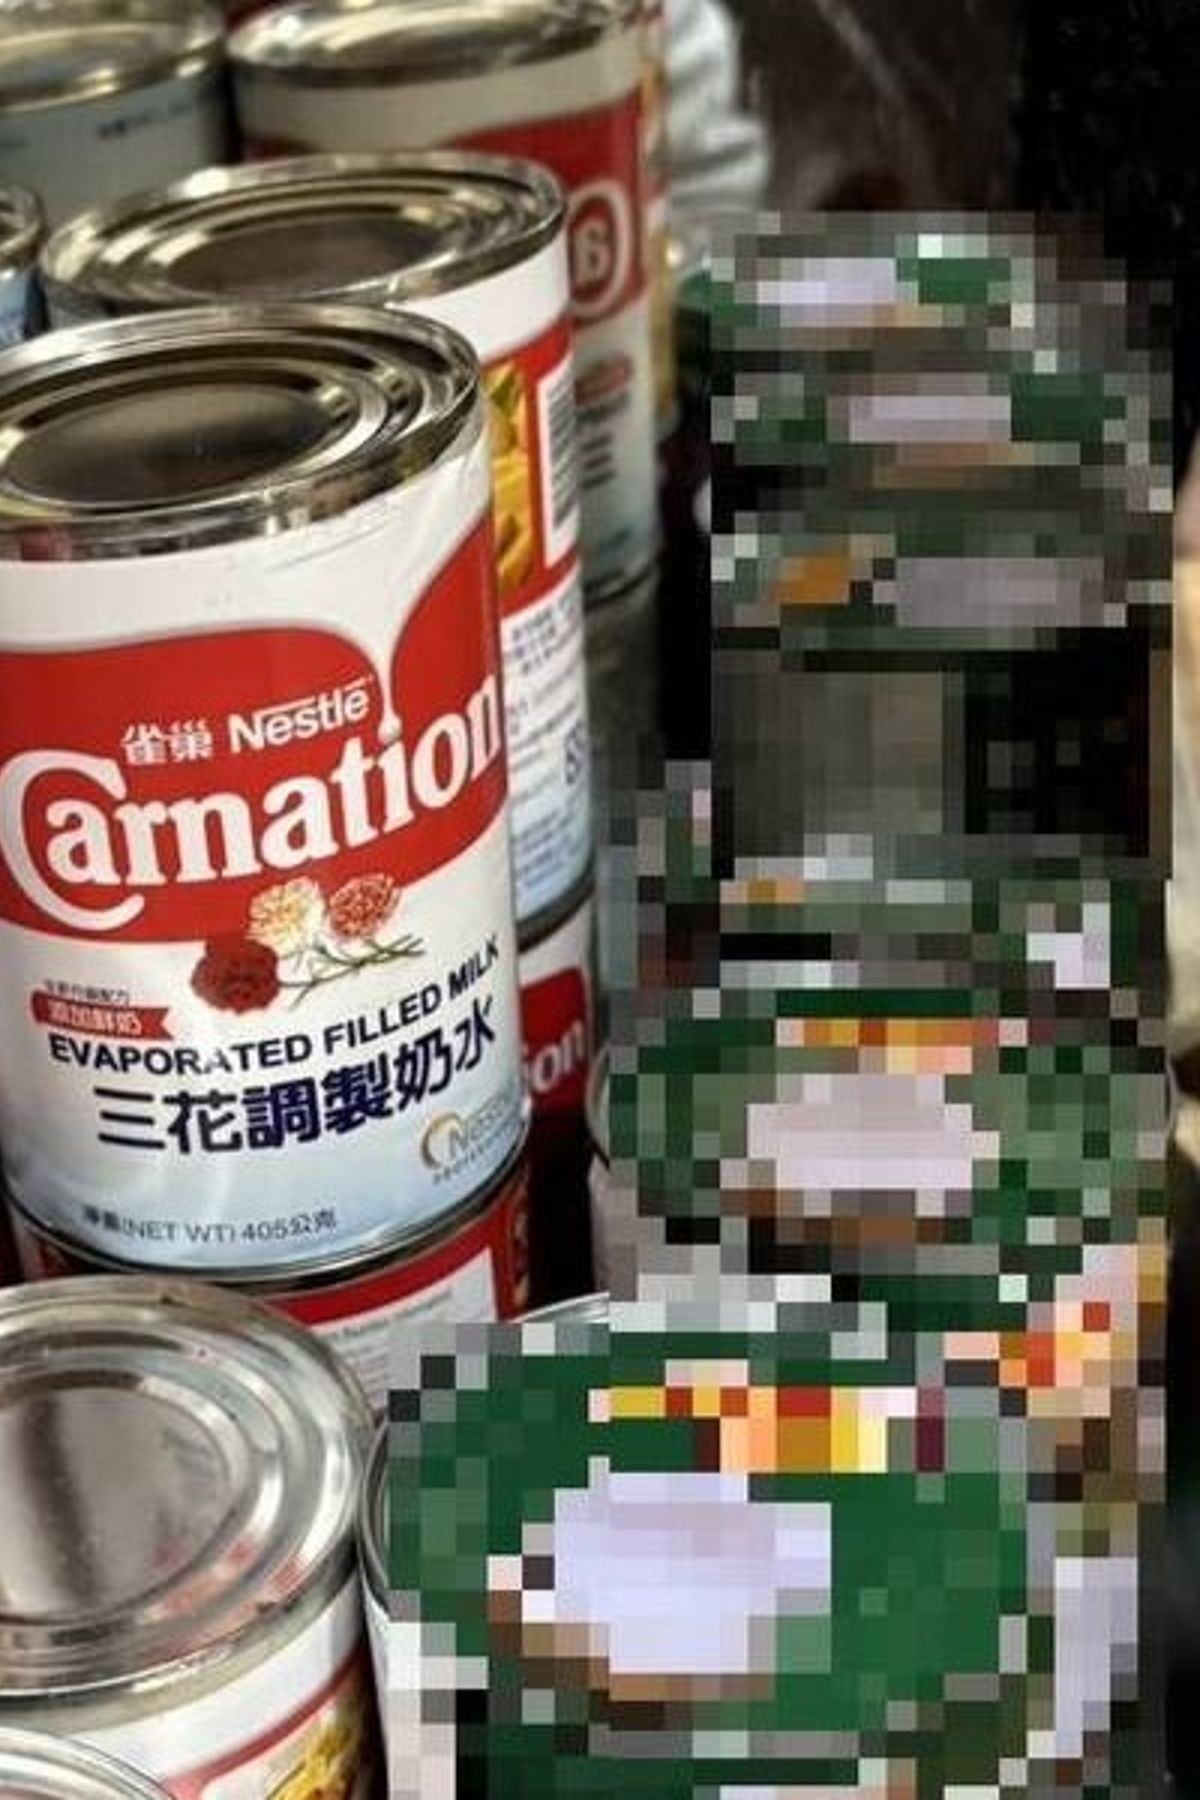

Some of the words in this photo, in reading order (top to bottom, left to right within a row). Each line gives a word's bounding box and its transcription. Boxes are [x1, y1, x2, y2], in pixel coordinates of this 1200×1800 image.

[48, 1032, 313, 1077] EVAPORATED
[323, 983, 442, 1056] FILLED
[448, 933, 500, 1000] MILK
[93, 995, 496, 1155] 三花調製奶水
